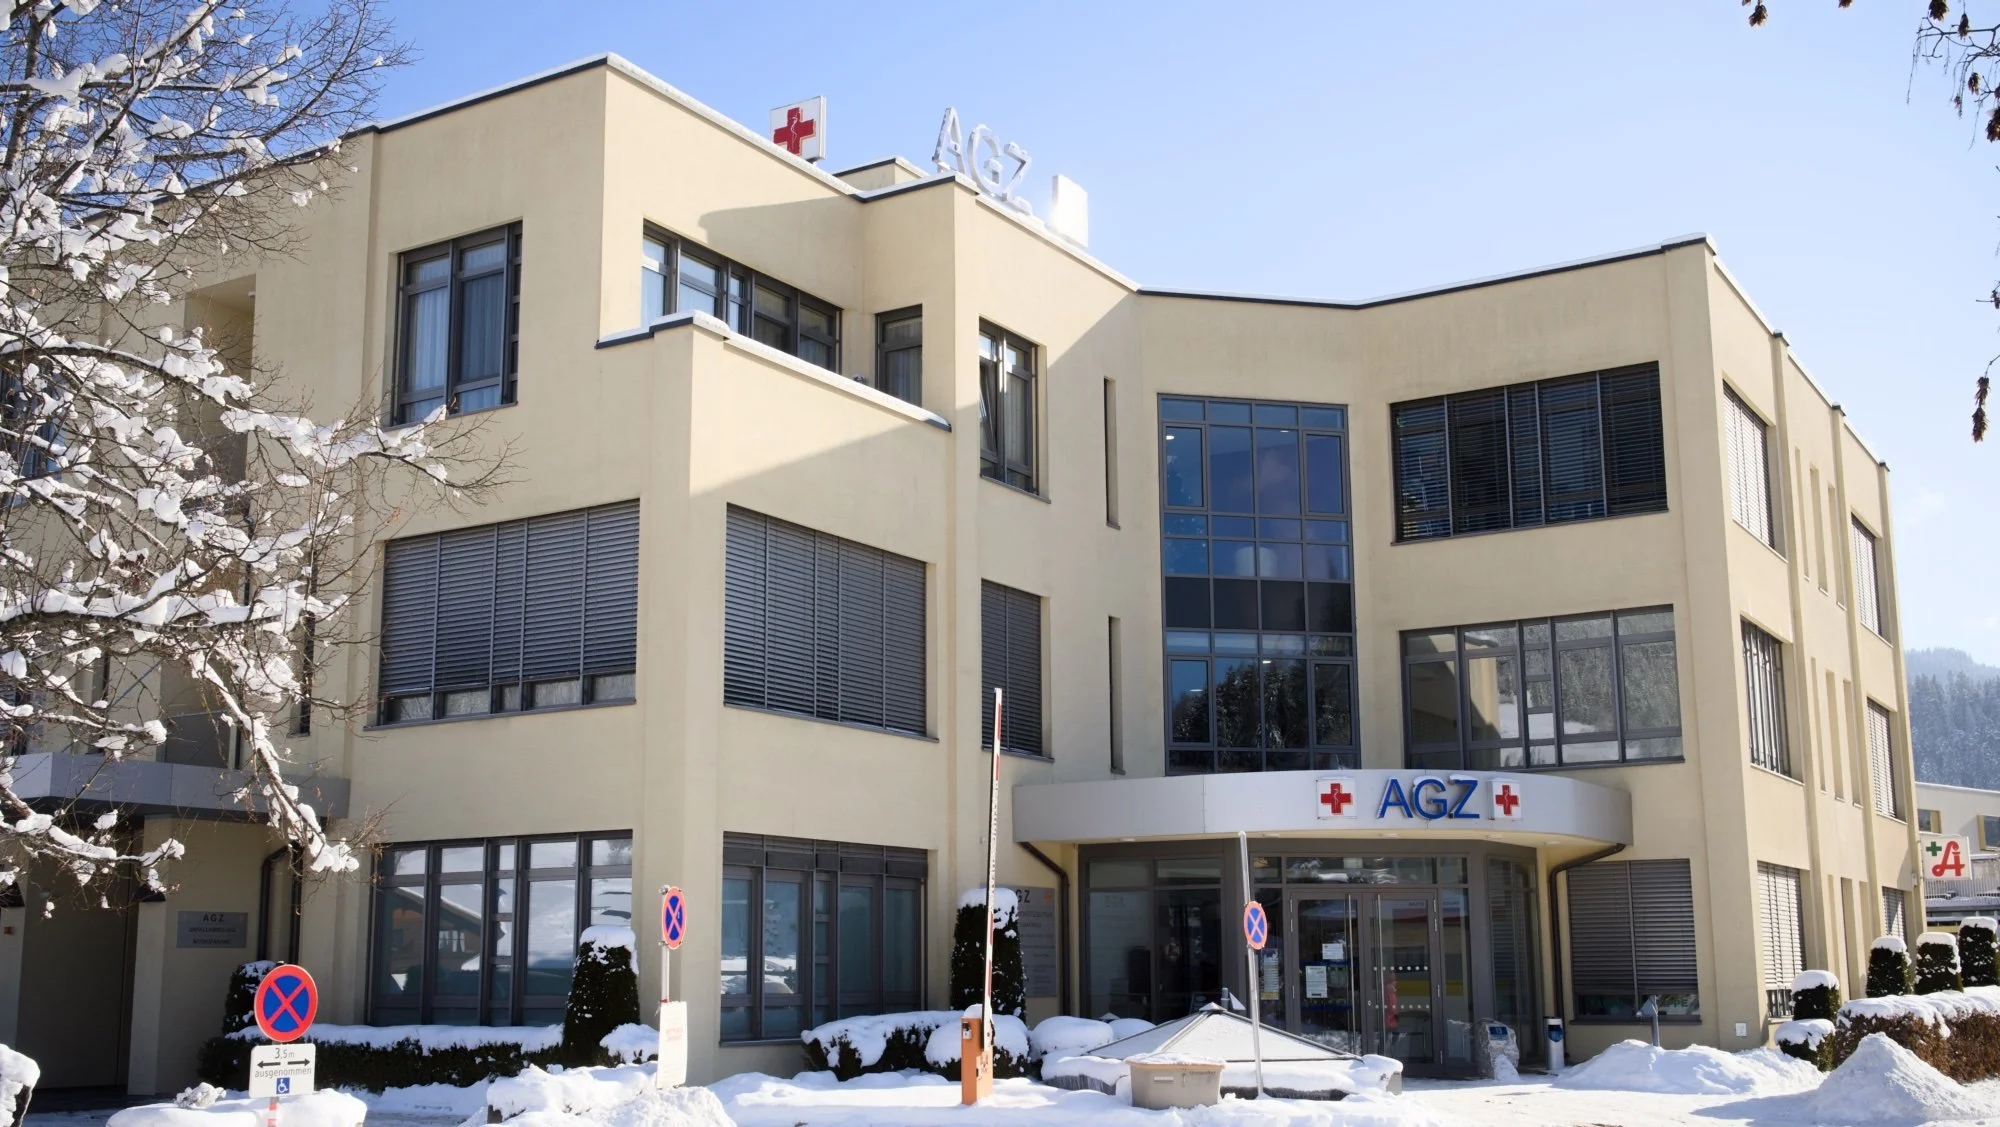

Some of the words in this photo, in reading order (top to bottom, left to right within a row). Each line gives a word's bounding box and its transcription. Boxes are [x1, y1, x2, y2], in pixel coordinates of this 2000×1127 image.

[932, 107, 1032, 212] AGZ
[1377, 776, 1480, 820] AGZ
[202, 913, 225, 923] AGZ
[254, 1067, 312, 1079] ausgenommen
